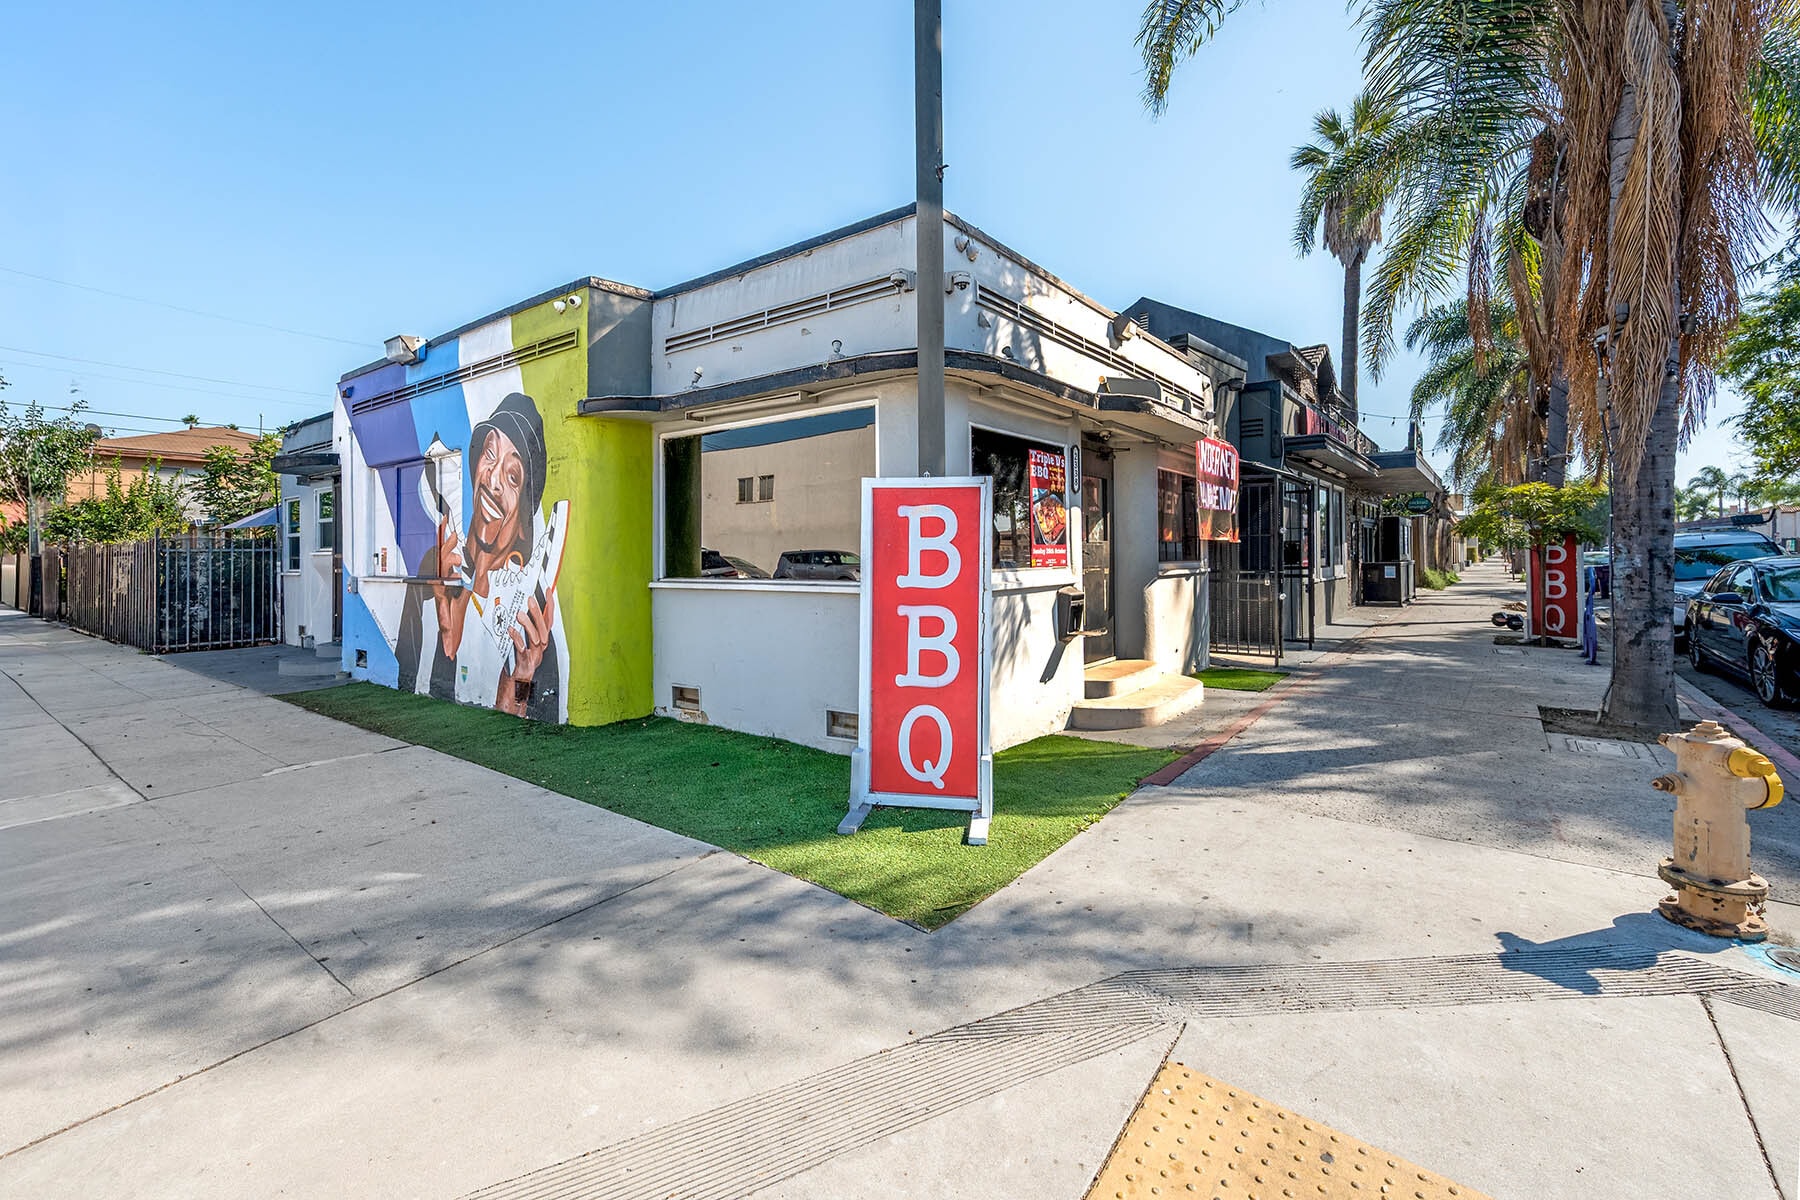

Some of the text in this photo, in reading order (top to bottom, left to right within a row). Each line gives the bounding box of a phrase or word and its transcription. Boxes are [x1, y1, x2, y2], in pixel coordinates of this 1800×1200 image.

[1030, 450, 1055, 466] Triple
[1031, 464, 1049, 479] BBQ
[895, 504, 963, 790] BBQ
